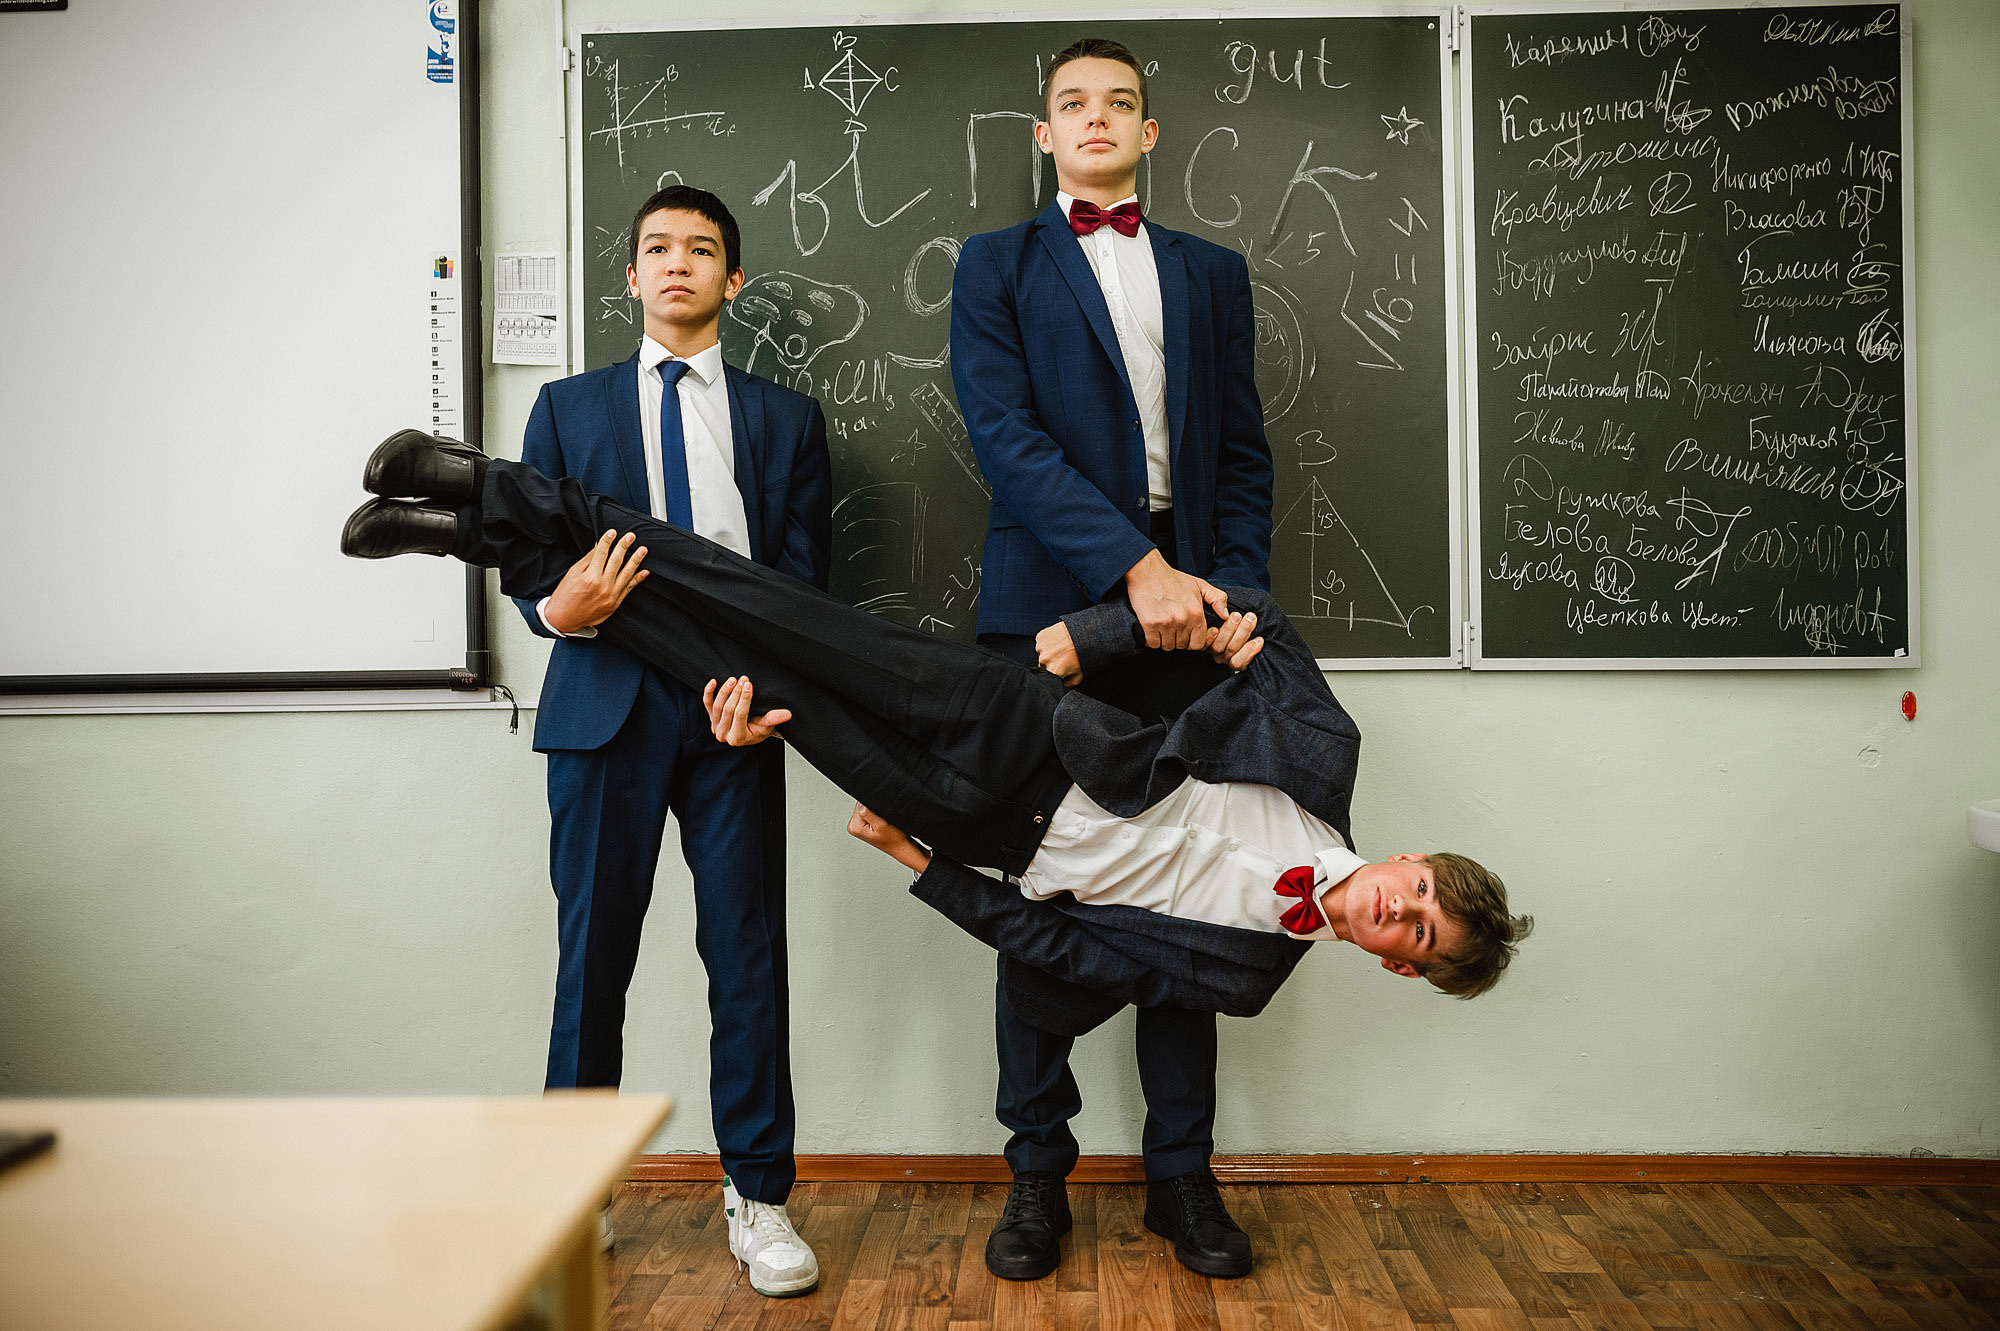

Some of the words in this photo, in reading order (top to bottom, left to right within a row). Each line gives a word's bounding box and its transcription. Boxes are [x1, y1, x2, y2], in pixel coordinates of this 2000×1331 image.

[1215, 37, 1351, 104] gut
[1491, 175, 1634, 244] Кравцевич
[1724, 200, 1827, 236] Власова
[1505, 503, 1611, 554] Белова
[1567, 598, 1672, 634] Цветкова
